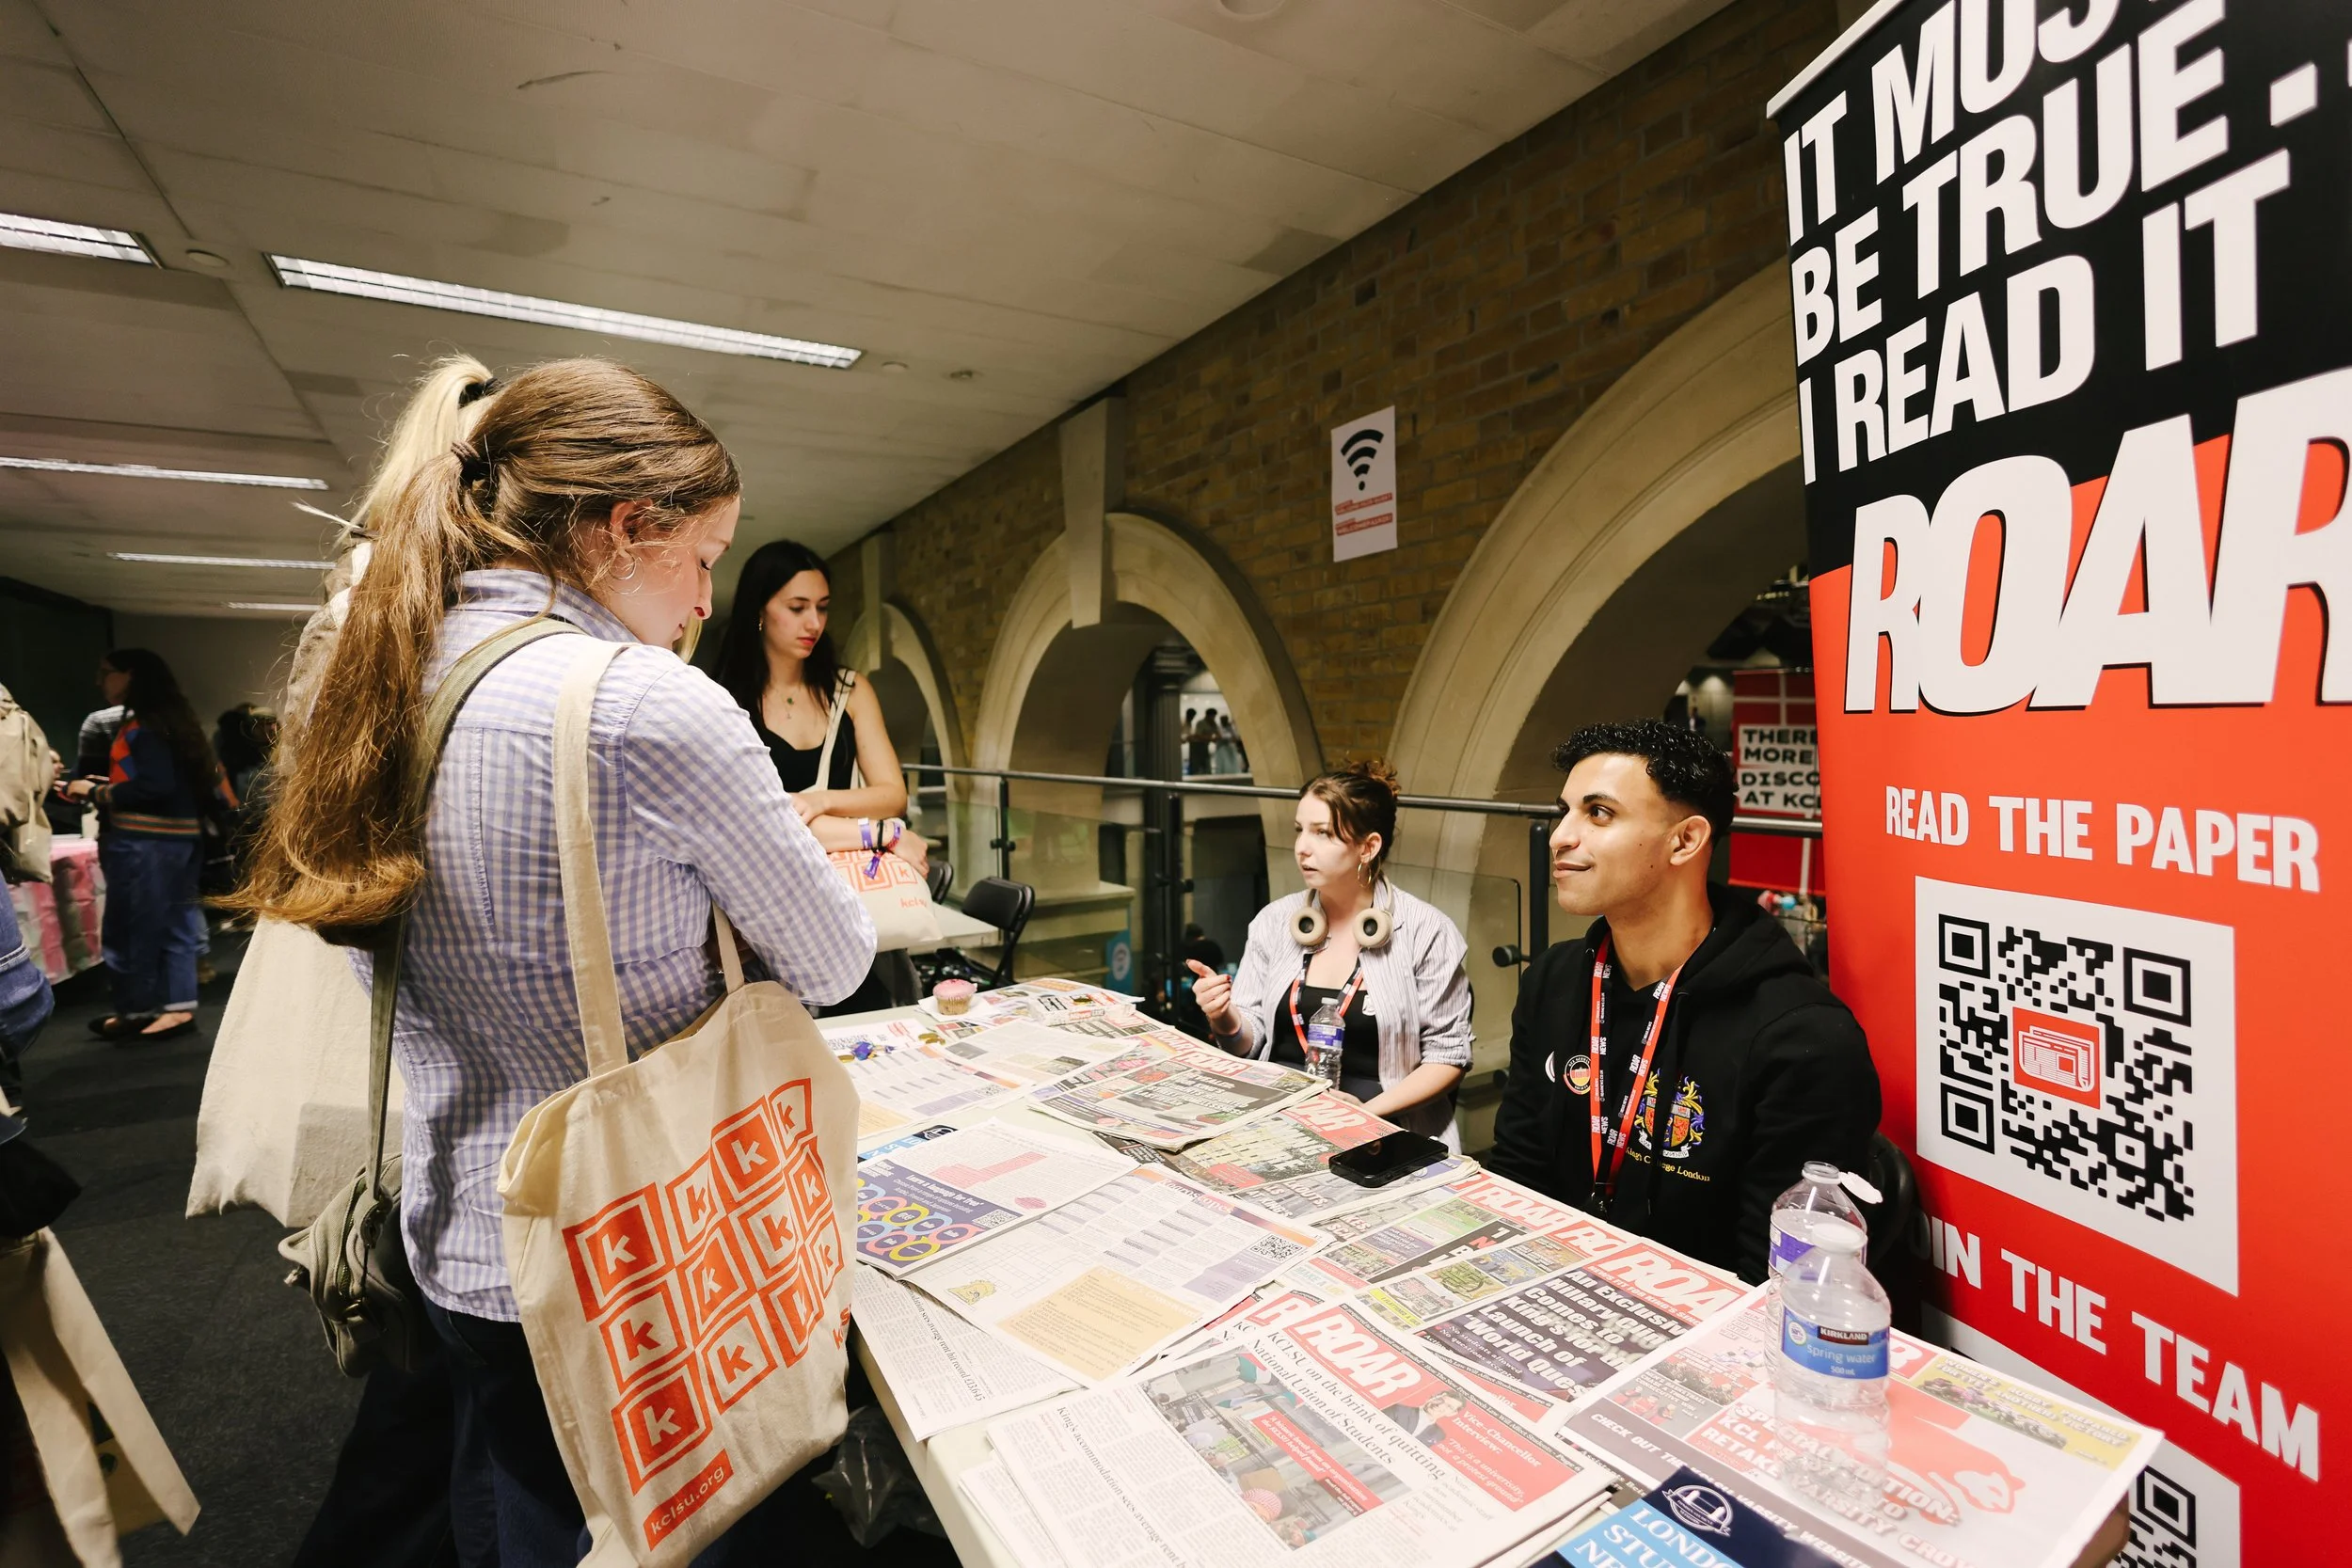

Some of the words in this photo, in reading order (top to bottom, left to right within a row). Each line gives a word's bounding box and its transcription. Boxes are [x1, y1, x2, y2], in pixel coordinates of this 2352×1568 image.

[1785, 91, 1847, 245] IT
[1872, 0, 2156, 184] MU
[1791, 206, 1882, 366] BE
[1902, 0, 2229, 300] TRUE
[1799, 378, 1816, 485] I
[1835, 254, 2095, 472] READ
[2142, 148, 2290, 371] IT
[1844, 365, 2352, 717] ROAR
[1743, 748, 1813, 765] MORE
[1744, 791, 1774, 806] AT
[1885, 785, 1970, 847] READ
[1989, 796, 2093, 862] THE
[2116, 803, 2320, 894] PAPER
[1594, 962, 1604, 977] ROAR
[1602, 964, 1612, 978] NEWS
[1653, 981, 1665, 999] ROAR
[1660, 984, 1671, 1002] NEWS
[1591, 1036, 1599, 1053] ROAR
[1184, 1053, 1248, 1075] ROAR
[1629, 1054, 1641, 1073] ROAR
[1638, 1058, 1648, 1078] NEWS
[1591, 1116, 1600, 1132] ROAR
[1607, 1129, 1618, 1146] ROAR
[1616, 1132, 1626, 1148] NEWS
[1677, 1166, 1710, 1181] London
[1561, 1270, 1602, 1288] An
[1583, 1266, 1616, 1281] NEWS
[1611, 1278, 1630, 1288] FIT
[1624, 1286, 1649, 1297] FOR
[1602, 1251, 1742, 1317] ROA
[1517, 1286, 1609, 1330] Comes
[1593, 1326, 1629, 1344] to
[1536, 1277, 1628, 1321] Hillary
[1437, 1329, 1455, 1338] No
[1470, 1304, 1567, 1353] Launch
[1549, 1348, 1588, 1369] of
[1495, 1295, 1579, 1336] King's
[1561, 1331, 1608, 1354] for
[1820, 1327, 1867, 1340] KIRKLAND
[1263, 1330, 1312, 1368] KCLSU
[1295, 1314, 1422, 1399] ROAR
[1445, 1325, 1463, 1335] No
[1454, 1333, 1495, 1354] students
[1486, 1352, 1527, 1374] allowed
[1846, 1354, 1876, 1364] water
[2001, 1247, 2106, 1354] THE
[2131, 1310, 2321, 1482] TEAM
[1303, 1366, 1324, 1382] on
[1319, 1377, 1346, 1398] the
[1245, 1338, 1299, 1381] National
[1289, 1376, 1331, 1409] Union
[1323, 1403, 1347, 1421] of
[1335, 1415, 1398, 1465] Students
[1339, 1392, 1379, 1424] brink
[1373, 1419, 1397, 1438] of
[1434, 1371, 1446, 1380] The
[1443, 1377, 1458, 1388] New
[1486, 1406, 1501, 1417] Law
[1498, 1414, 1513, 1425] Will
[1509, 1421, 1528, 1435] Affect
[1524, 1433, 1553, 1452] Students
[1555, 1452, 1576, 1467] Page
[1590, 1412, 1631, 1438] CHECK
[1629, 1433, 1661, 1455] OUT
[1716, 1413, 1763, 1443] KCL
[1260, 1418, 1274, 1427] the
[1283, 1441, 1307, 1458] helped
[1292, 1436, 1312, 1450] break
[1305, 1449, 1326, 1463] from
[1449, 1417, 1506, 1454] Interview:
[1456, 1410, 1547, 1467] Vice-Chancellor
[1384, 1431, 1448, 1481] quitting
[1436, 1442, 1454, 1454] not
[1455, 1459, 1488, 1481] protest
[1464, 1451, 1477, 1460] is
[1700, 1425, 1788, 1481] RETAKE
[651, 1465, 724, 1534] kclsu.org
[1053, 1405, 1082, 1433] King's
[1072, 1431, 1126, 1496] accommodation
[1119, 1494, 1136, 1513] sees
[1132, 1511, 1163, 1545] average
[1159, 1542, 1181, 1563] rent
